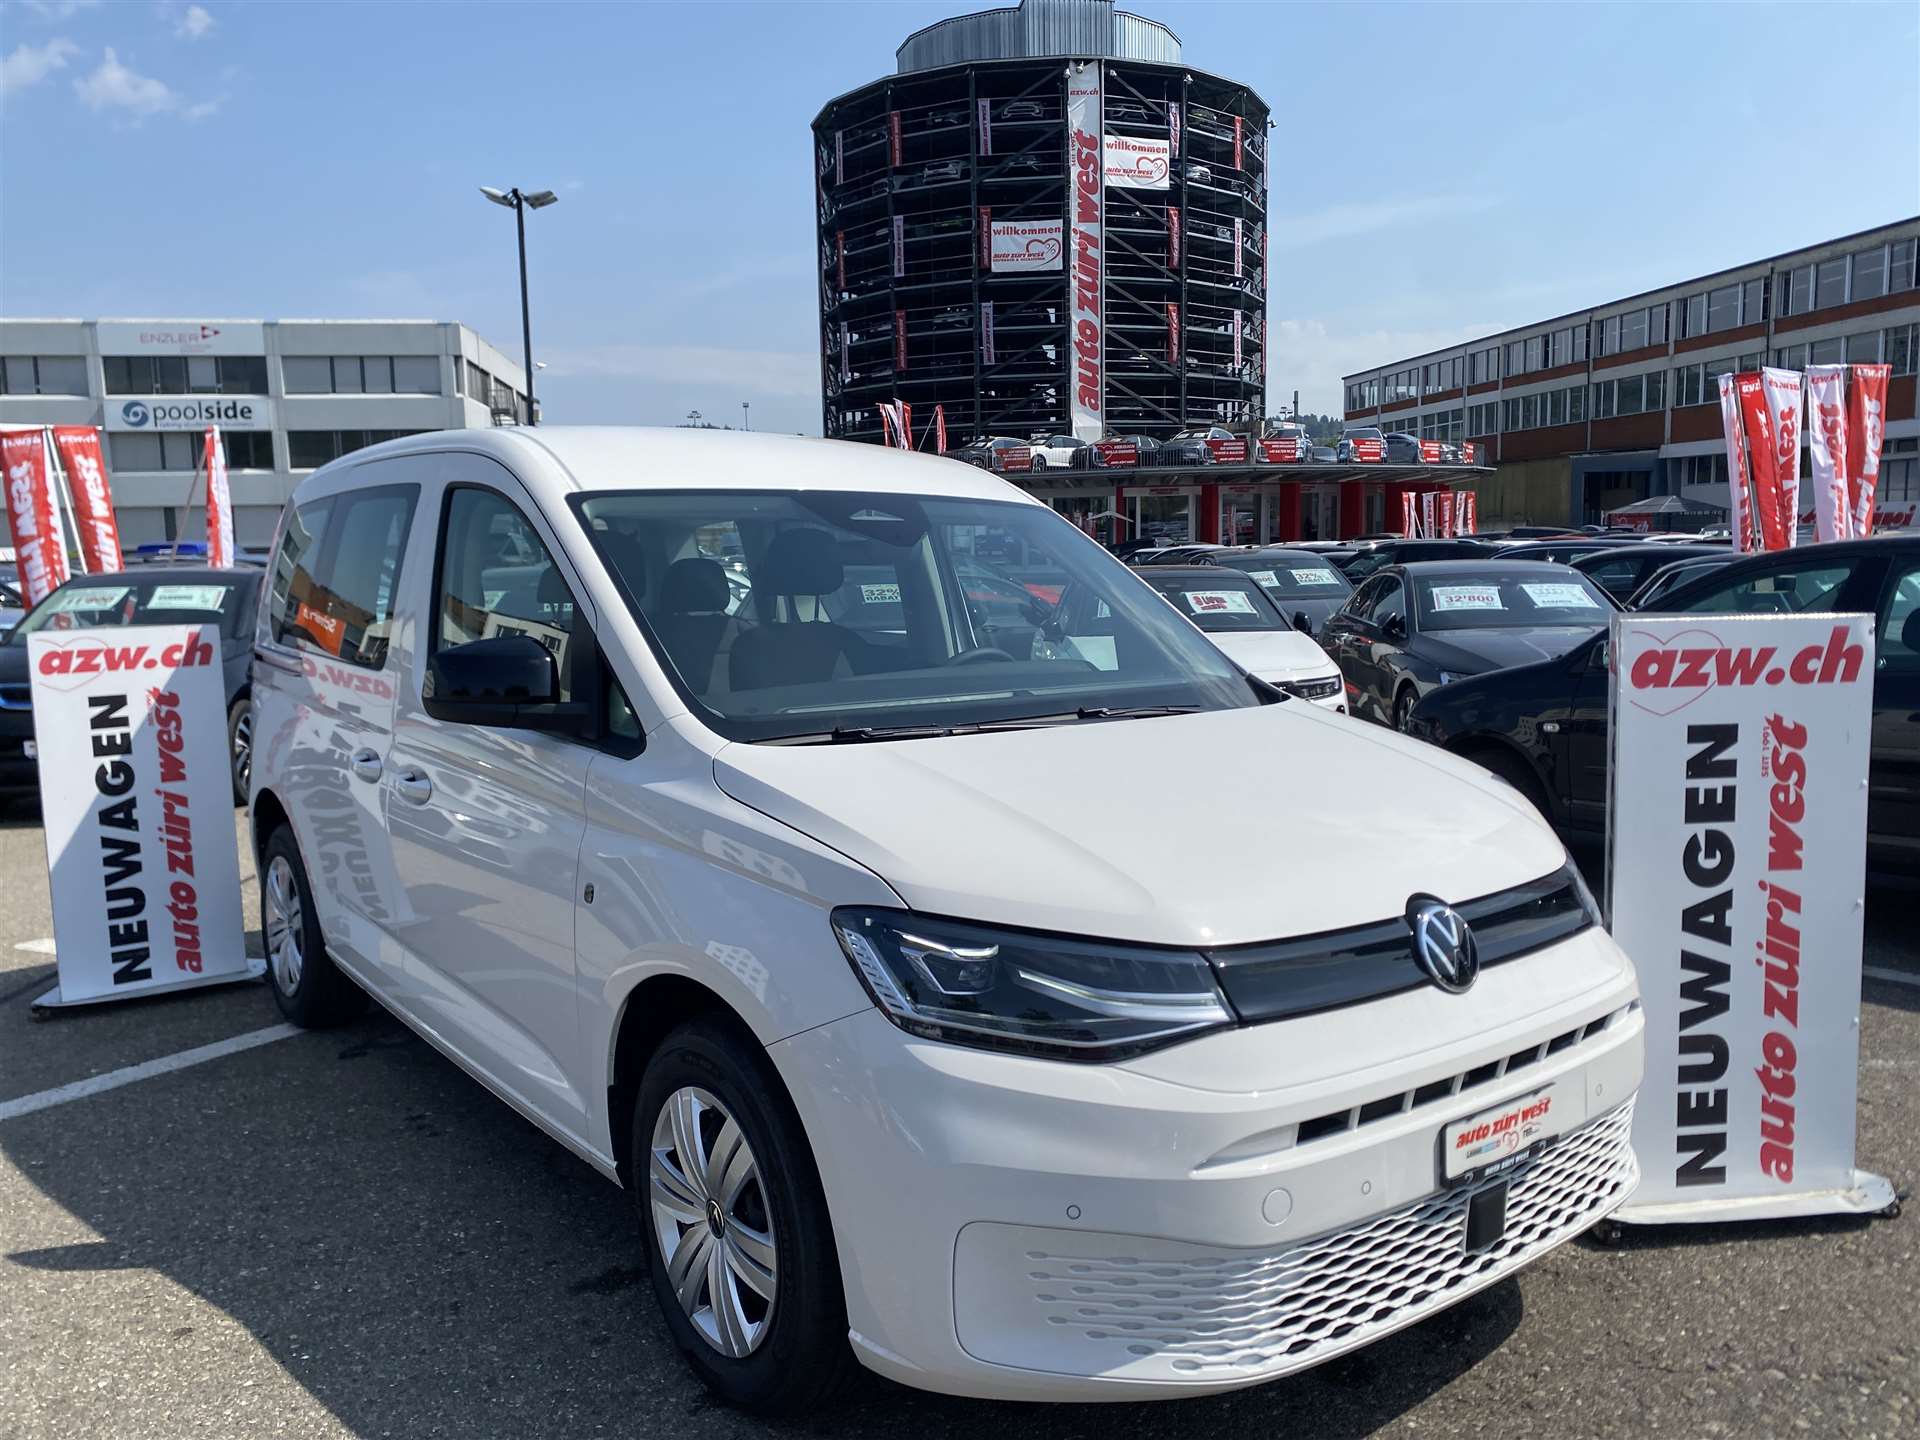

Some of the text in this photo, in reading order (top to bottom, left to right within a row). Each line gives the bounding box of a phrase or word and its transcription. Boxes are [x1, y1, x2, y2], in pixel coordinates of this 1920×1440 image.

[1070, 87, 1098, 96] azw.ch
[1105, 141, 1168, 154] willkommen
[992, 225, 1063, 236] willkommen
[1072, 128, 1100, 412] auto züri west
[139, 331, 199, 344] ENZLER
[152, 400, 253, 427] poolside
[38, 631, 214, 676] azw.ch
[1630, 625, 1864, 689] azw.ch
[1761, 757, 1769, 778] SEIT
[88, 693, 152, 985] NEUWAGEN
[150, 686, 204, 974] auto züri west
[1676, 723, 1739, 1188] NEUWAGEN
[1754, 712, 1808, 1185] auto züri west
[1456, 1122, 1491, 1150] auto
[1490, 1107, 1521, 1136] züri
[1521, 1096, 1552, 1123] west
